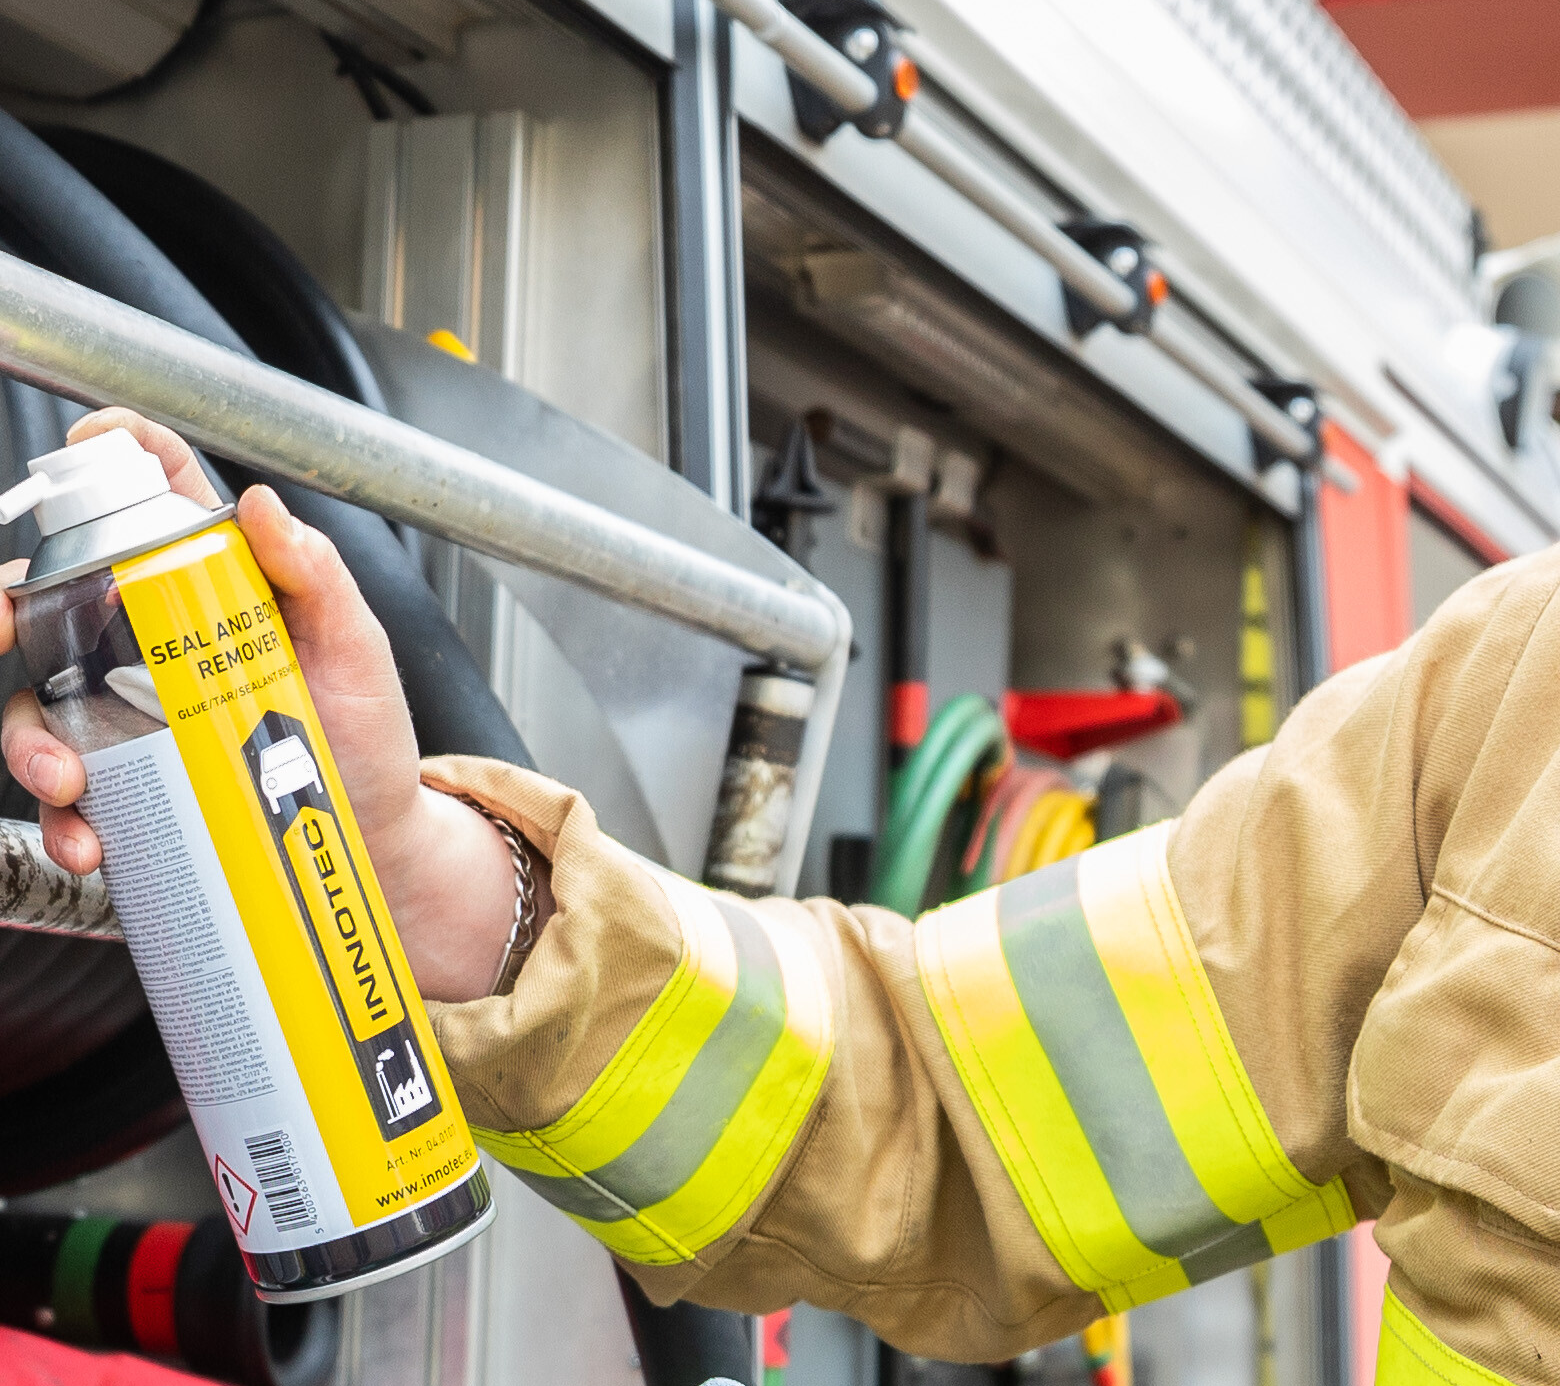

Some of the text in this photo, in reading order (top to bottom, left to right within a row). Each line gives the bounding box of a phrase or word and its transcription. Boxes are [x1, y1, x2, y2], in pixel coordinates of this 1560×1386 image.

[150, 631, 211, 665] SEAL
[217, 611, 252, 641] AND
[197, 630, 281, 680] REMOVER
[177, 671, 278, 720] GLUE/TAR/SEALANT
[302, 818, 388, 1021] INNOTEC
[386, 1158, 408, 1172] Art.
